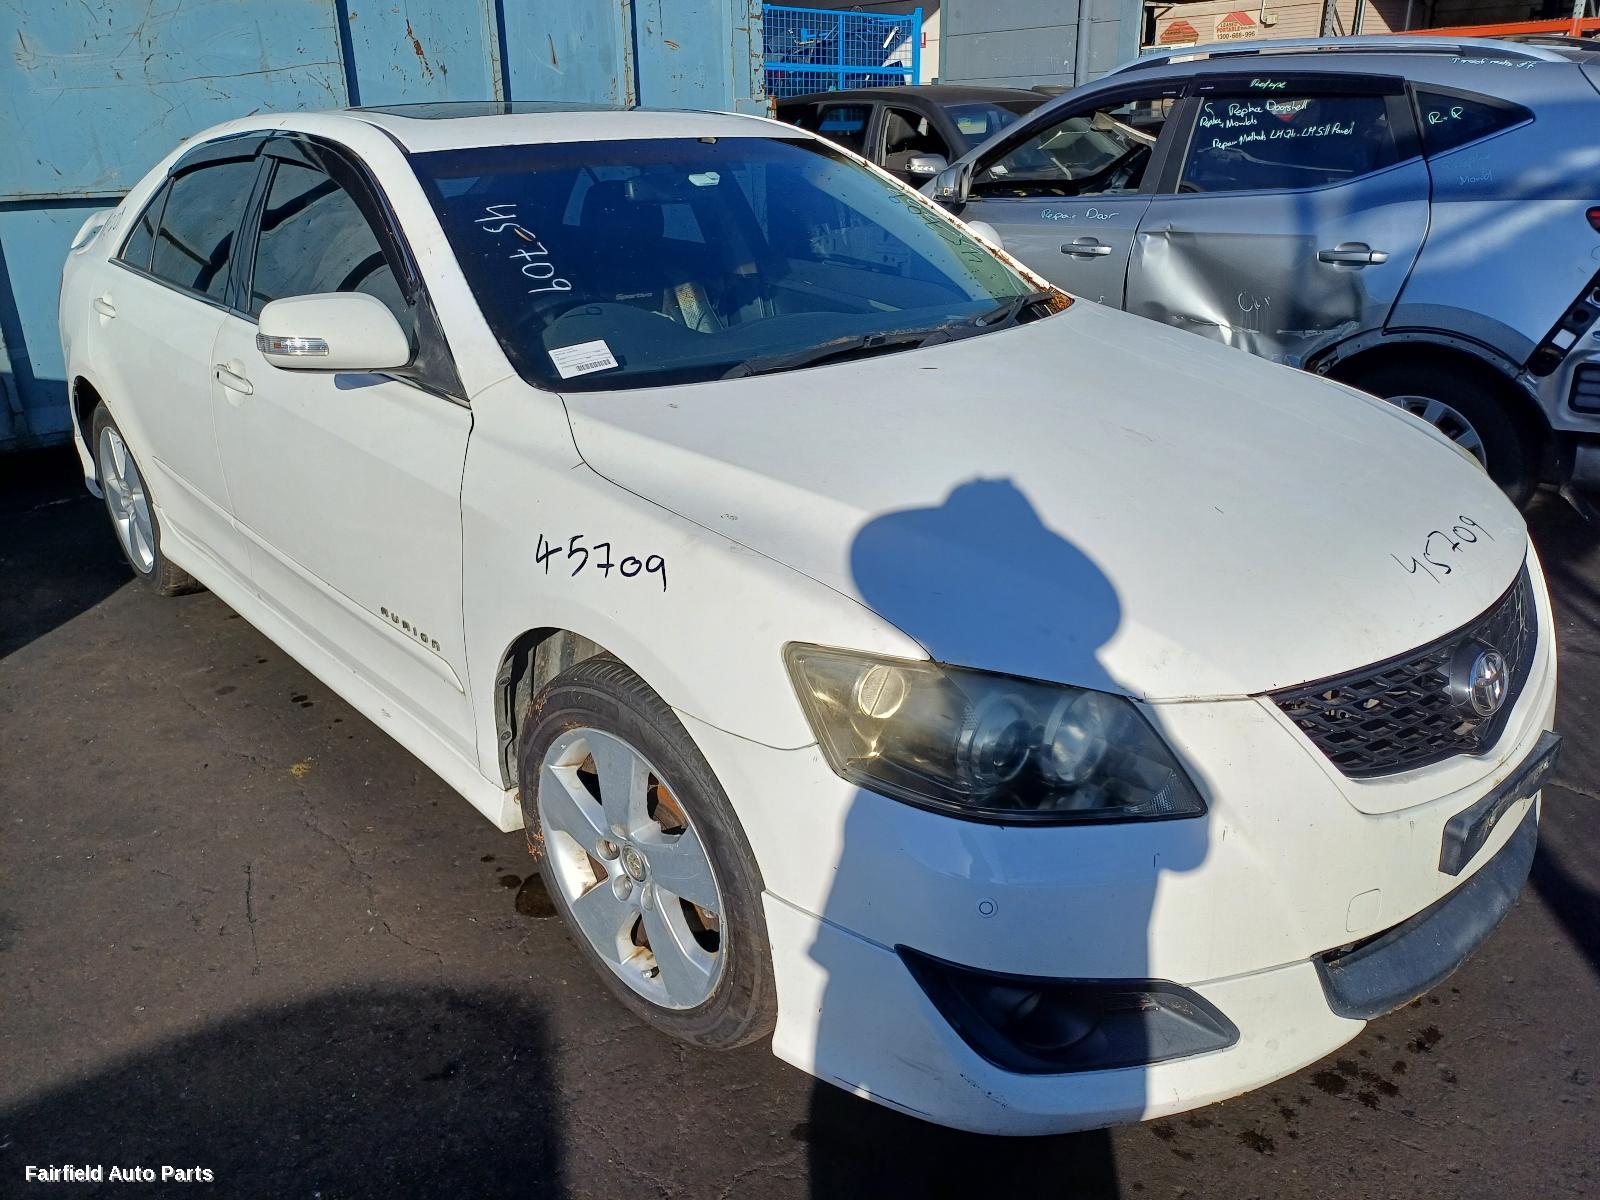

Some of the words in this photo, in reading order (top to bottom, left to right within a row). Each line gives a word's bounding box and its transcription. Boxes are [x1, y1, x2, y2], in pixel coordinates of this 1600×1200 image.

[1086, 207, 1120, 220] Door
[474, 203, 572, 294] 45709
[535, 533, 667, 593] 45709
[1388, 515, 1495, 584] 45709
[380, 606, 441, 652] AURION
